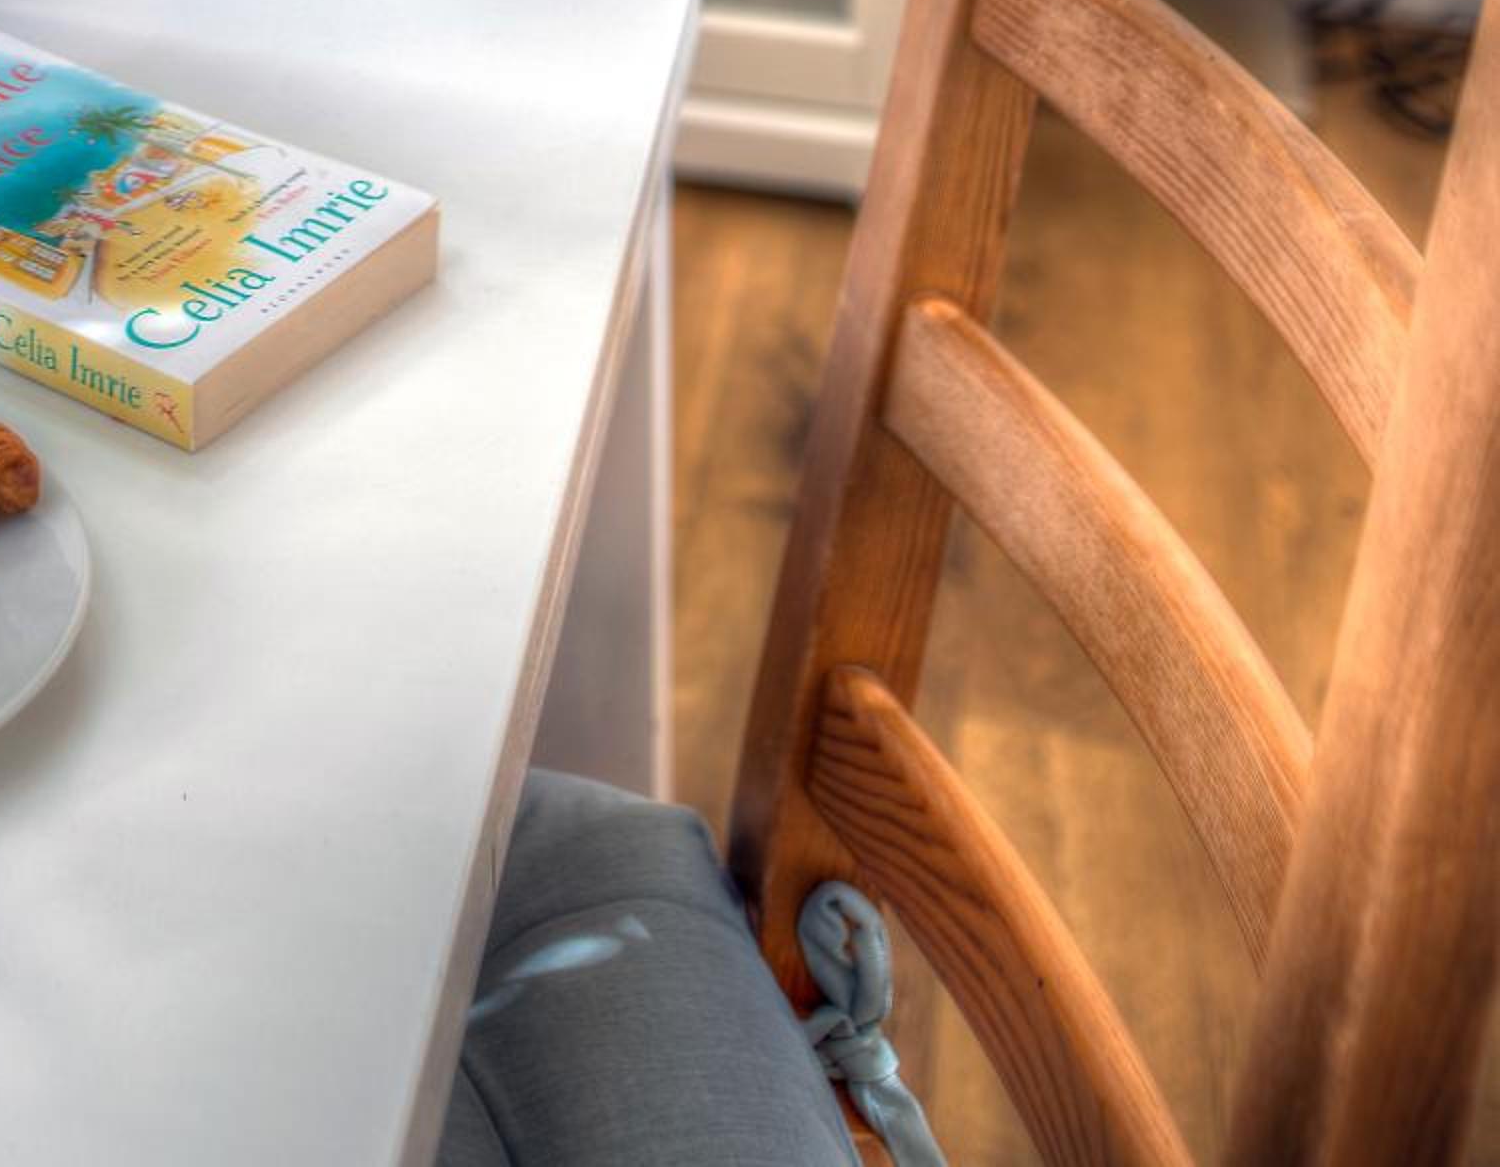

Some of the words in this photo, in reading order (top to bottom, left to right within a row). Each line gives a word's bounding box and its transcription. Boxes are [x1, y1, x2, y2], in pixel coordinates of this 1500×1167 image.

[125, 266, 276, 349] Celia
[240, 179, 389, 263] Imrie
[70, 345, 143, 409] Imrie
